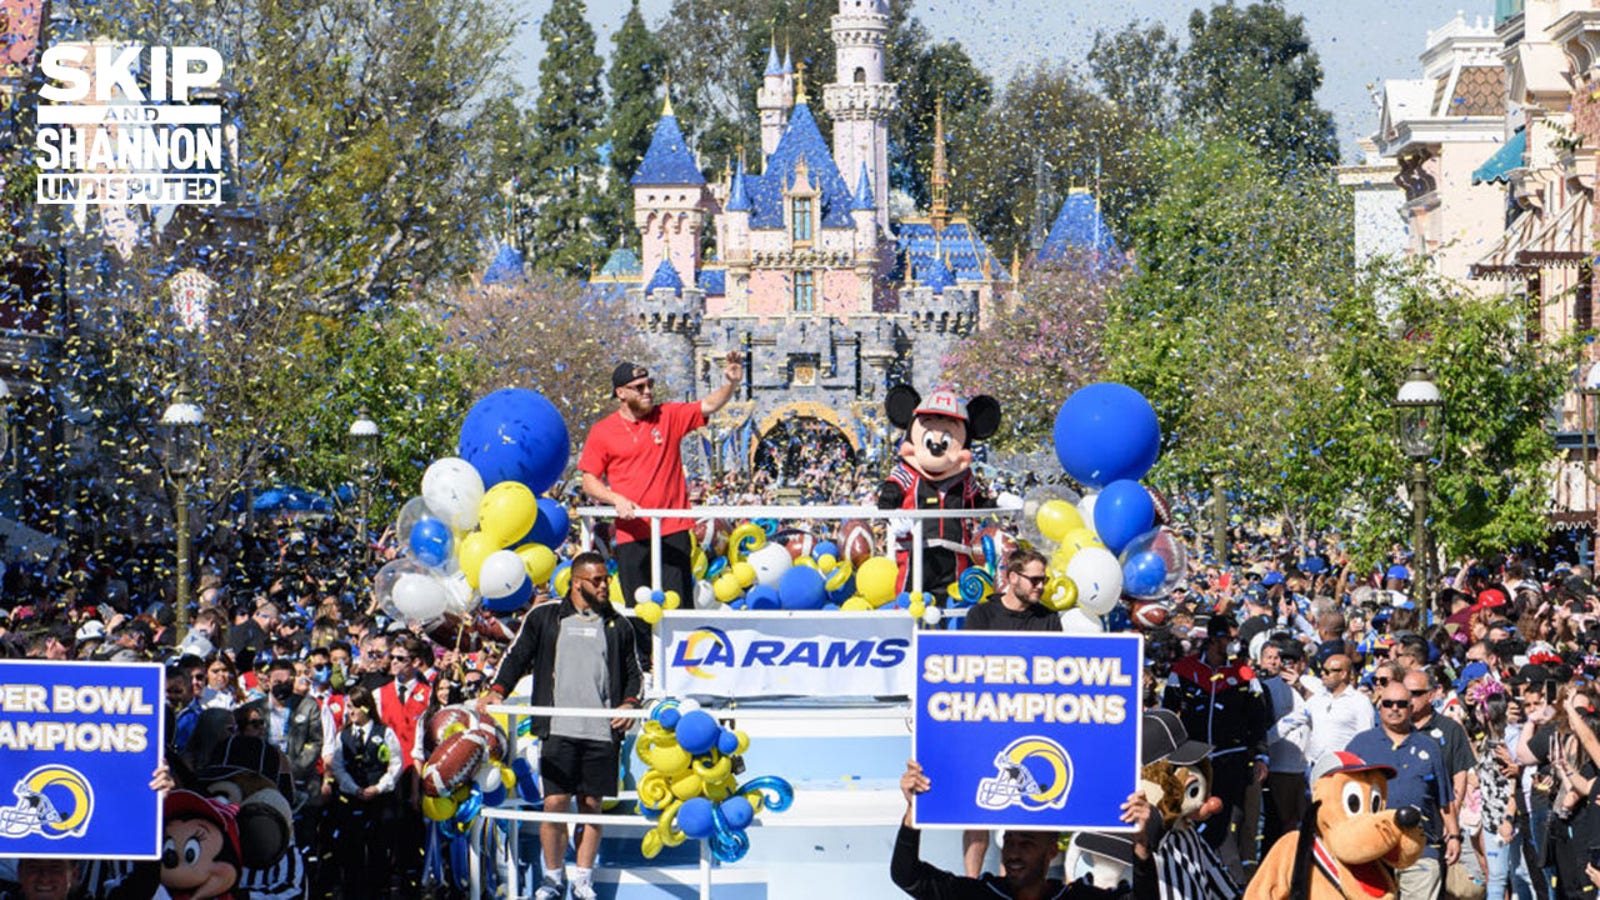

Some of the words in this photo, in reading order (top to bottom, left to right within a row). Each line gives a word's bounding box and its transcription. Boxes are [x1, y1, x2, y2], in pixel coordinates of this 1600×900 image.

[936, 396, 951, 406] M
[672, 627, 735, 674] LA
[741, 639, 909, 668] RAMS
[923, 654, 1030, 684] SUPER
[1032, 656, 1132, 687] BOWL
[0, 684, 51, 713] ER
[53, 685, 154, 715] BOWL
[927, 691, 1126, 725] CHAMPIONS
[0, 721, 148, 752] AMPIONS
